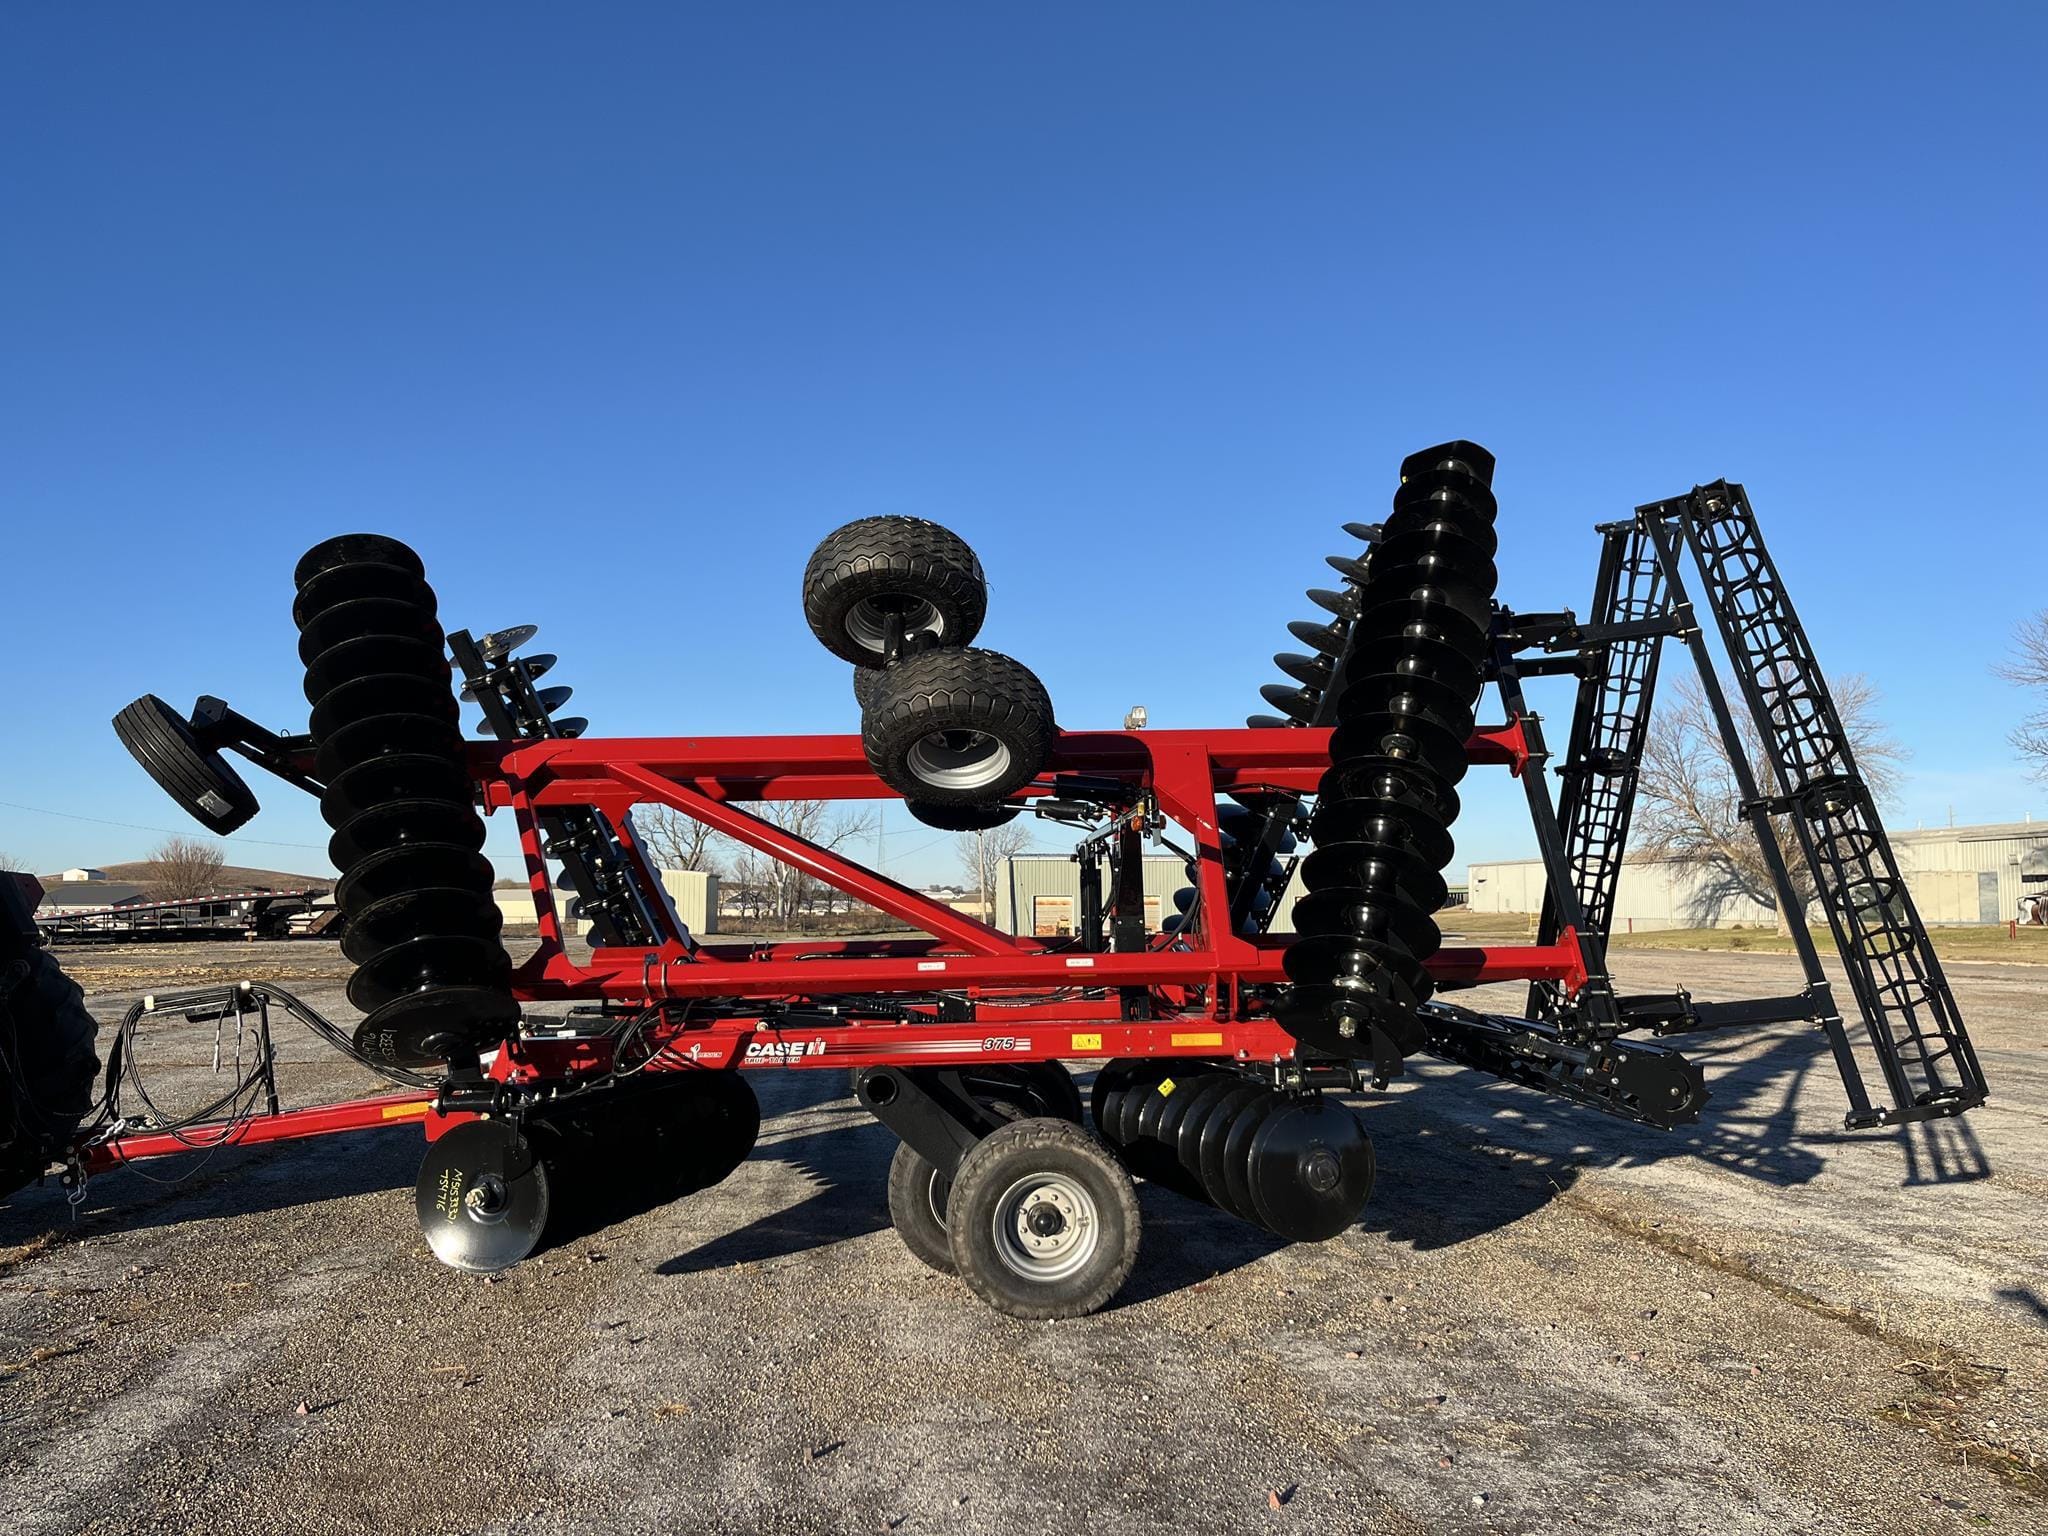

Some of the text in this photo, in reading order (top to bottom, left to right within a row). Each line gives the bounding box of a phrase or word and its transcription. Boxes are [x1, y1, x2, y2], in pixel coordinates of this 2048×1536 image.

[745, 1037, 827, 1057] CASE IH
[983, 1036, 1015, 1051] 375
